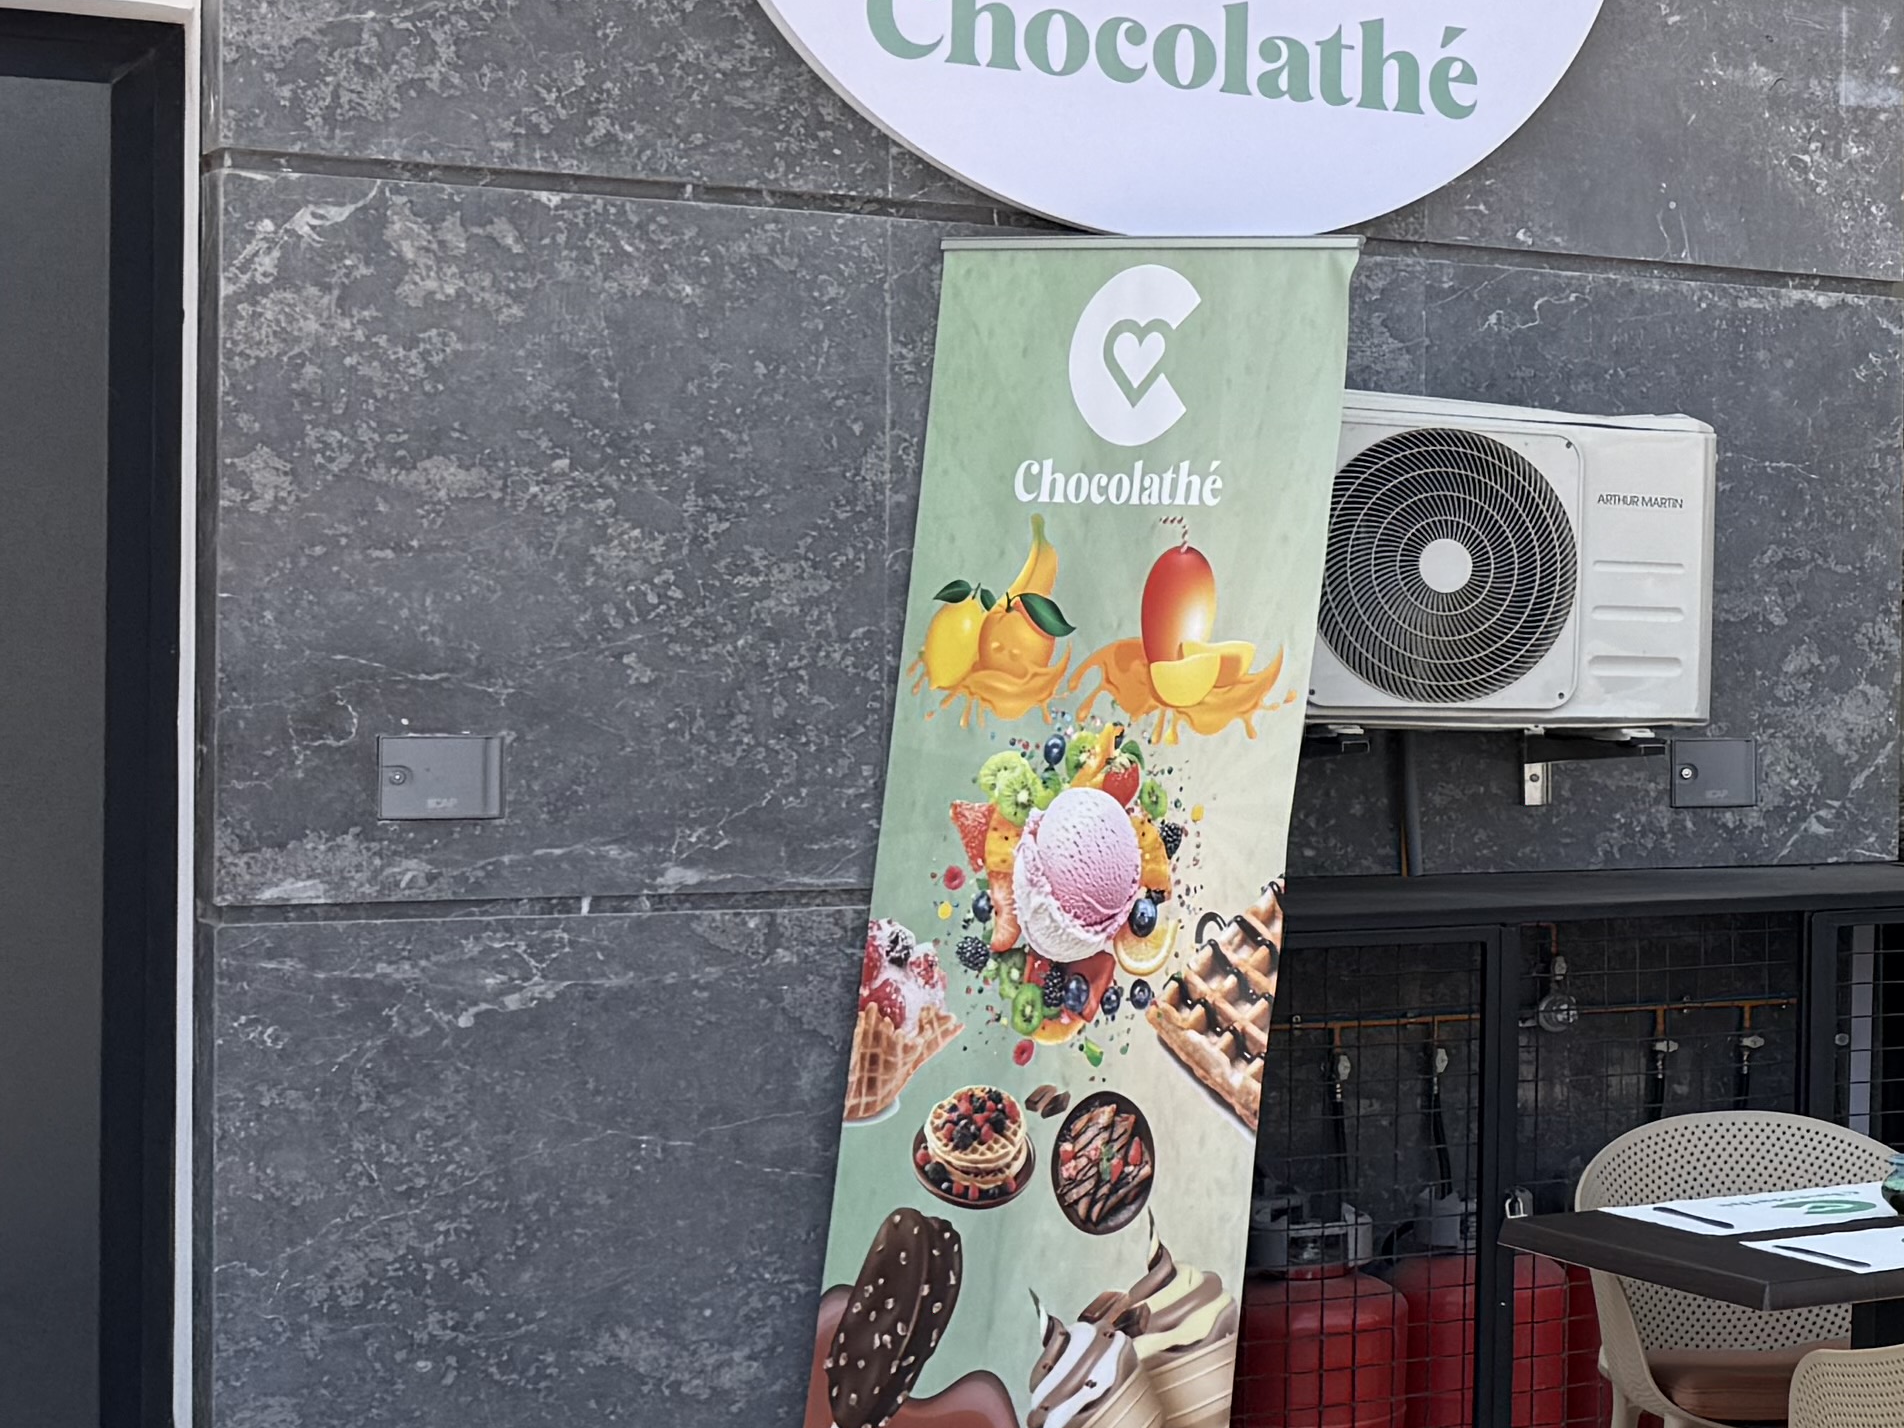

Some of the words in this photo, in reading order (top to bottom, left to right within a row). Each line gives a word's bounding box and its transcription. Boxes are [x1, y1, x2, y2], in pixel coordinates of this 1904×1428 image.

[1014, 458, 1223, 507] Chocolathé
[1597, 493, 1639, 507] ARTHUR
[1641, 495, 1684, 509] MARTIN
